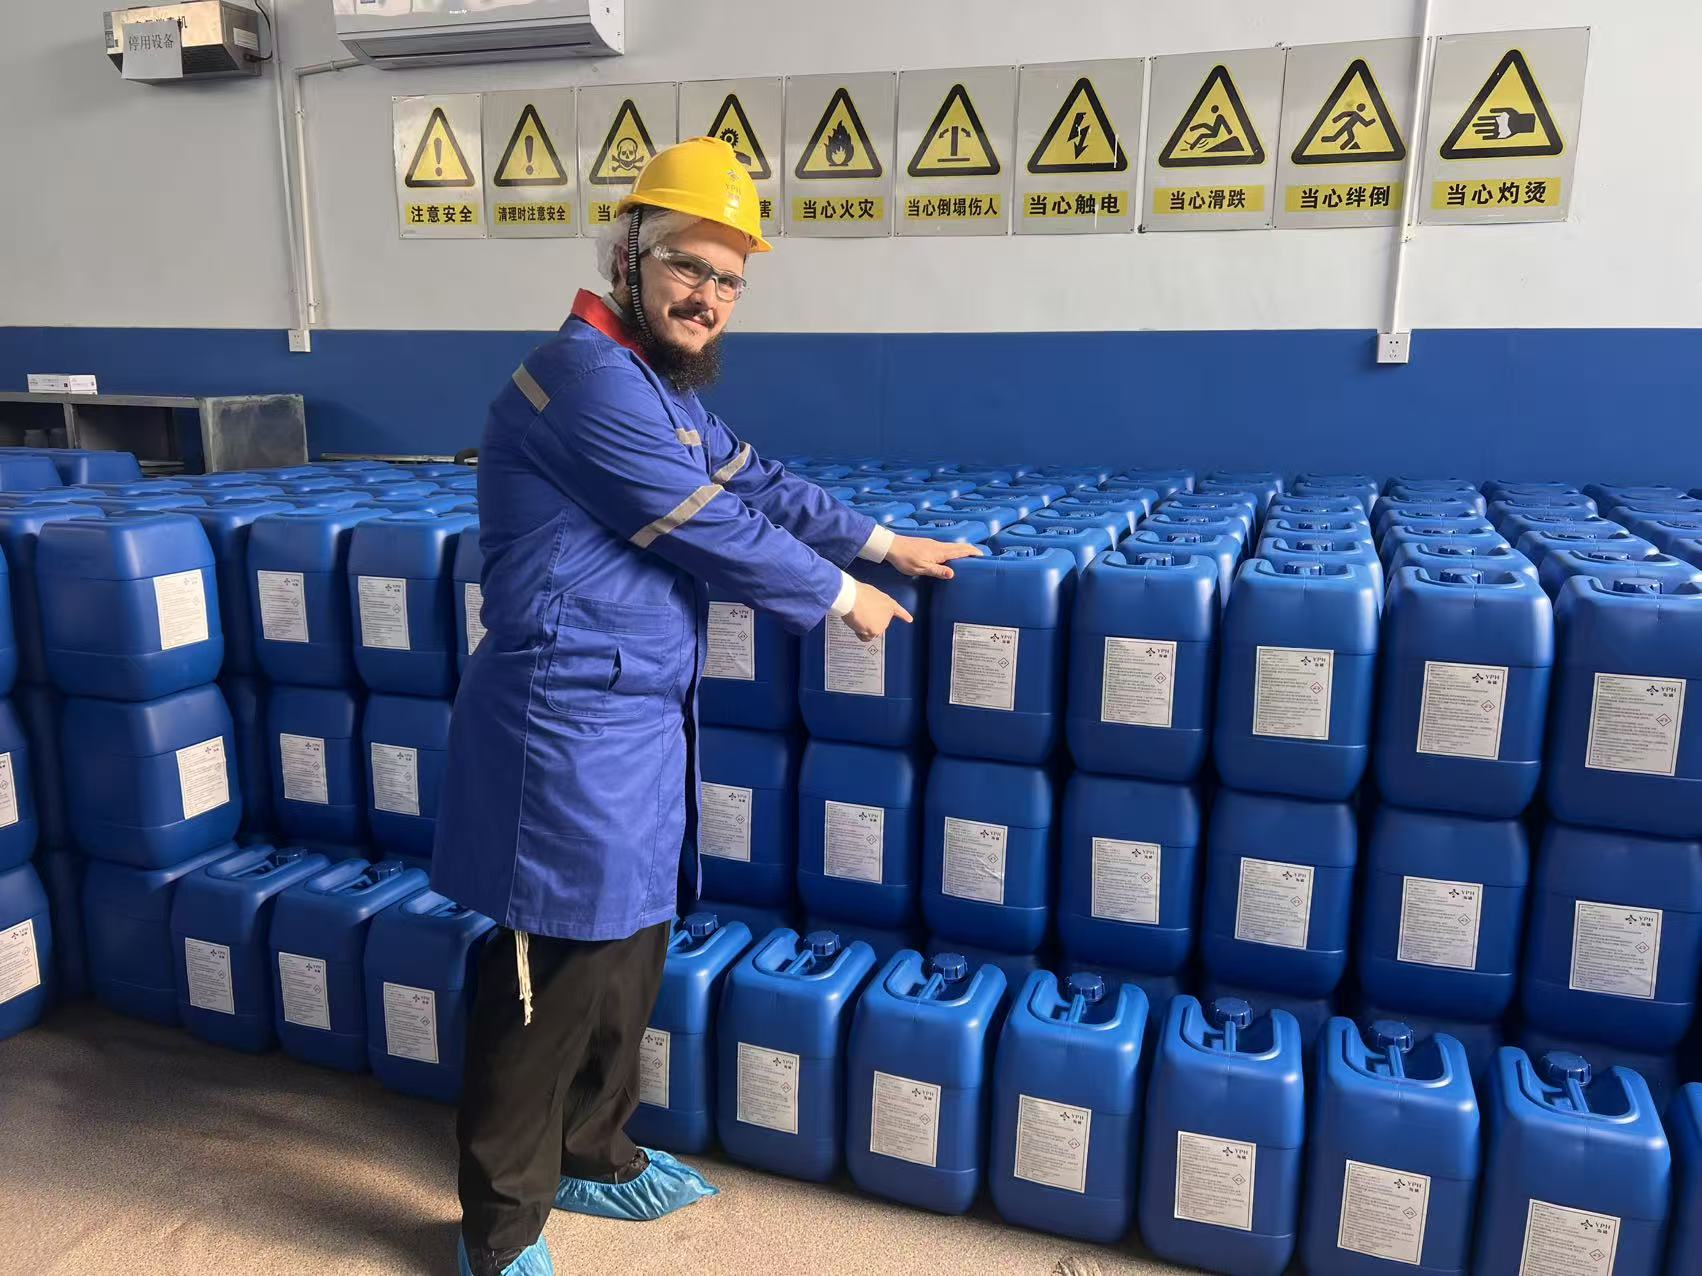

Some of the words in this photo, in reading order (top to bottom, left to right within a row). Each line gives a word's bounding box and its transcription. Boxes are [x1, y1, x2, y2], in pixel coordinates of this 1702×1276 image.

[128, 33, 174, 51] 停用设备
[1028, 193, 1121, 216] 当心触电
[1169, 188, 1246, 211] 当心滑跌
[1300, 185, 1391, 209] 当心绊倒
[1446, 181, 1547, 206] 当心灼烫
[410, 205, 474, 223] 注意安全
[498, 205, 566, 222] 清理时注意安全
[802, 198, 874, 220] 当心火灾
[907, 197, 998, 217] 当心倒塌伤人
